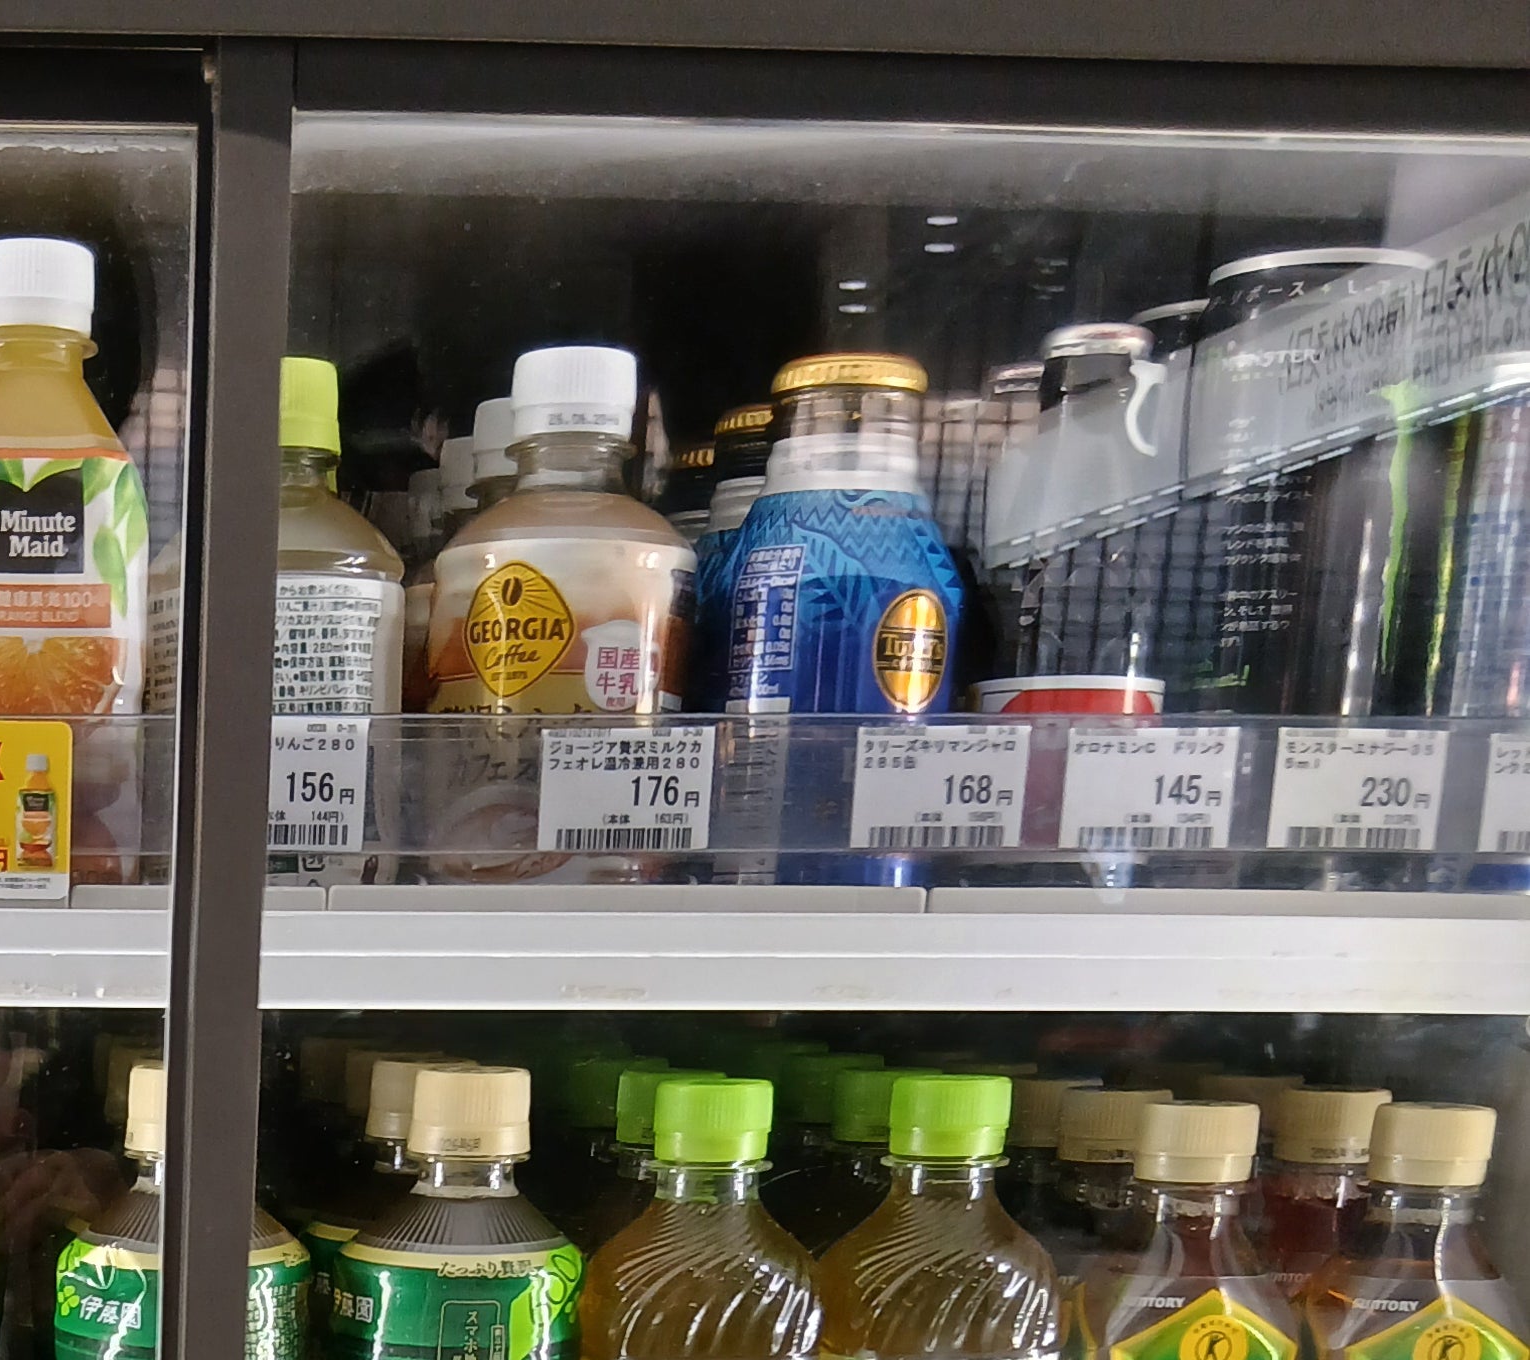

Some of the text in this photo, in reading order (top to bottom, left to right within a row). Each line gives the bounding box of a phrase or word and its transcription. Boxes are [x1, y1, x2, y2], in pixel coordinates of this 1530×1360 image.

[0, 510, 76, 534] Minute
[9, 534, 67, 559] Maid
[470, 618, 565, 645] GEORGIA
[484, 643, 540, 670] Coffee
[597, 646, 641, 671] 国産
[596, 672, 640, 697] 牛乳
